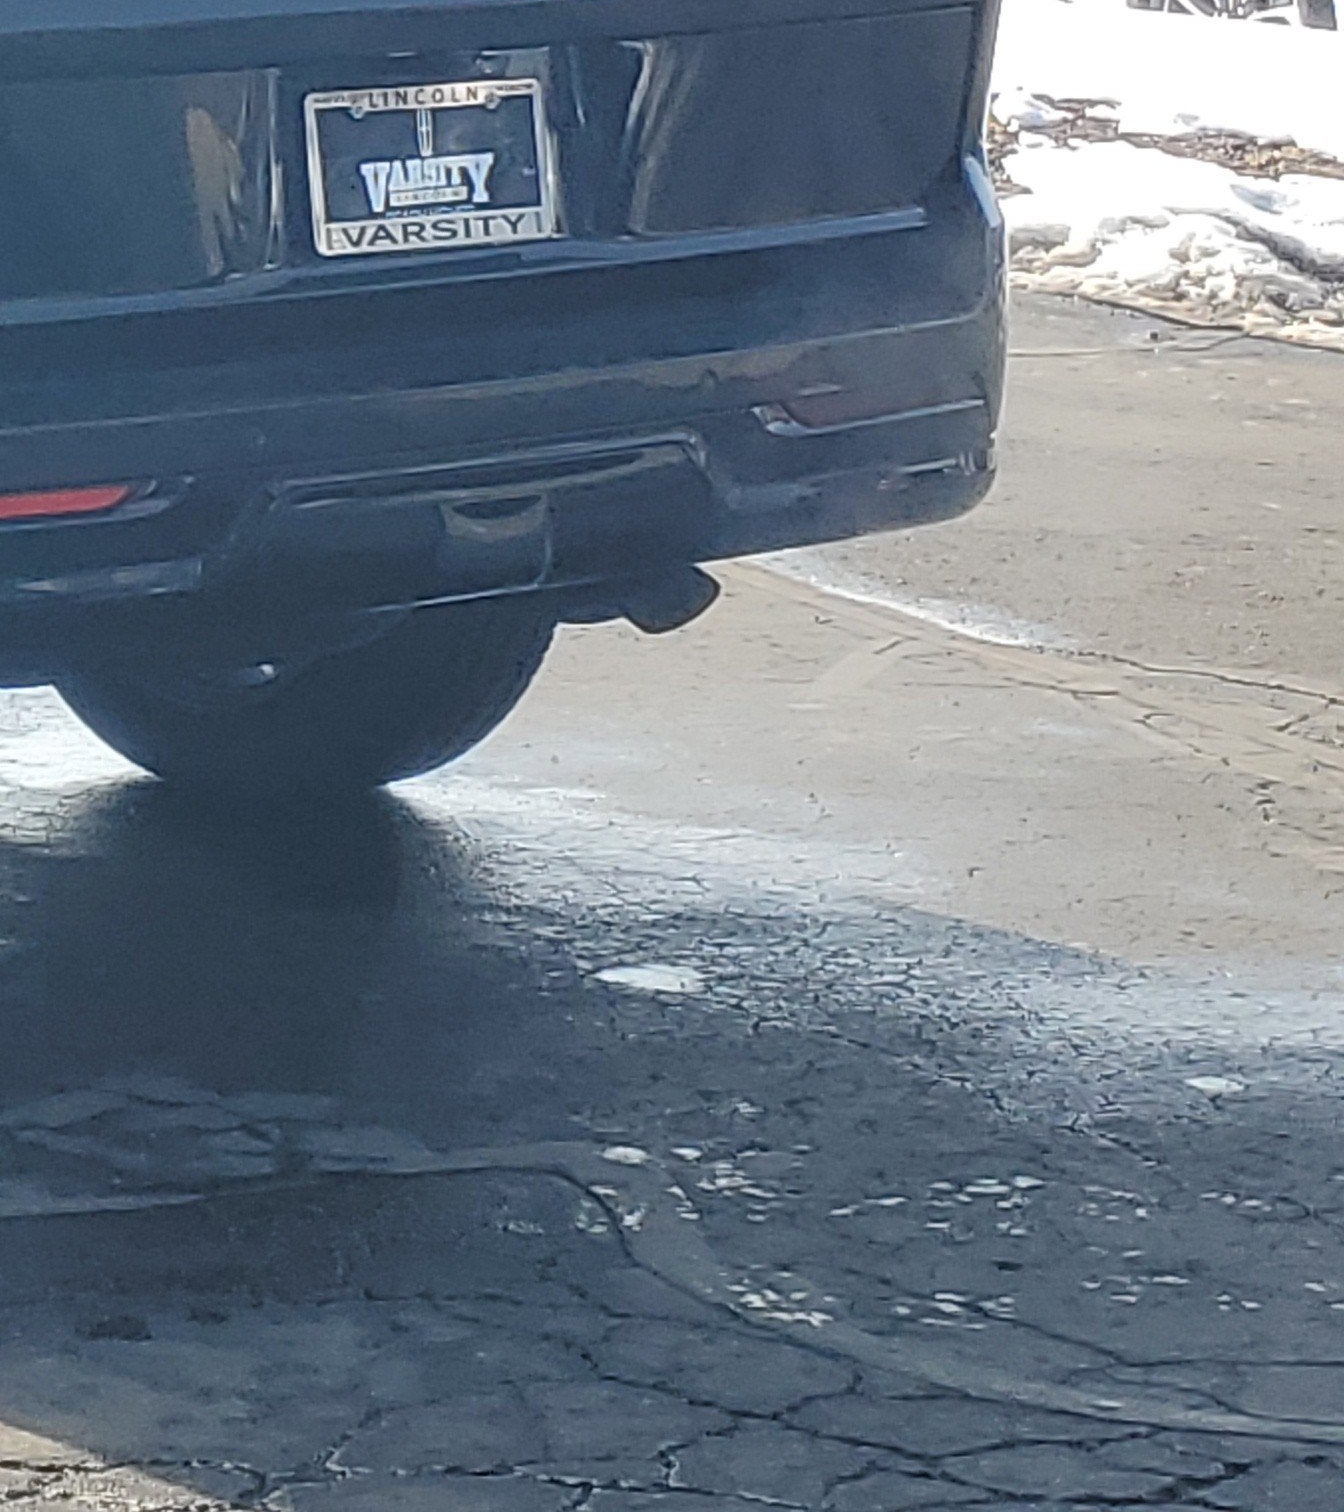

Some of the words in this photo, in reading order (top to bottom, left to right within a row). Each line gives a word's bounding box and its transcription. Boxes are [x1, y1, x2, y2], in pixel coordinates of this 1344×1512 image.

[367, 86, 480, 109] LINCOLN
[359, 152, 494, 213] VARSITY
[341, 214, 527, 248] VARSITY
